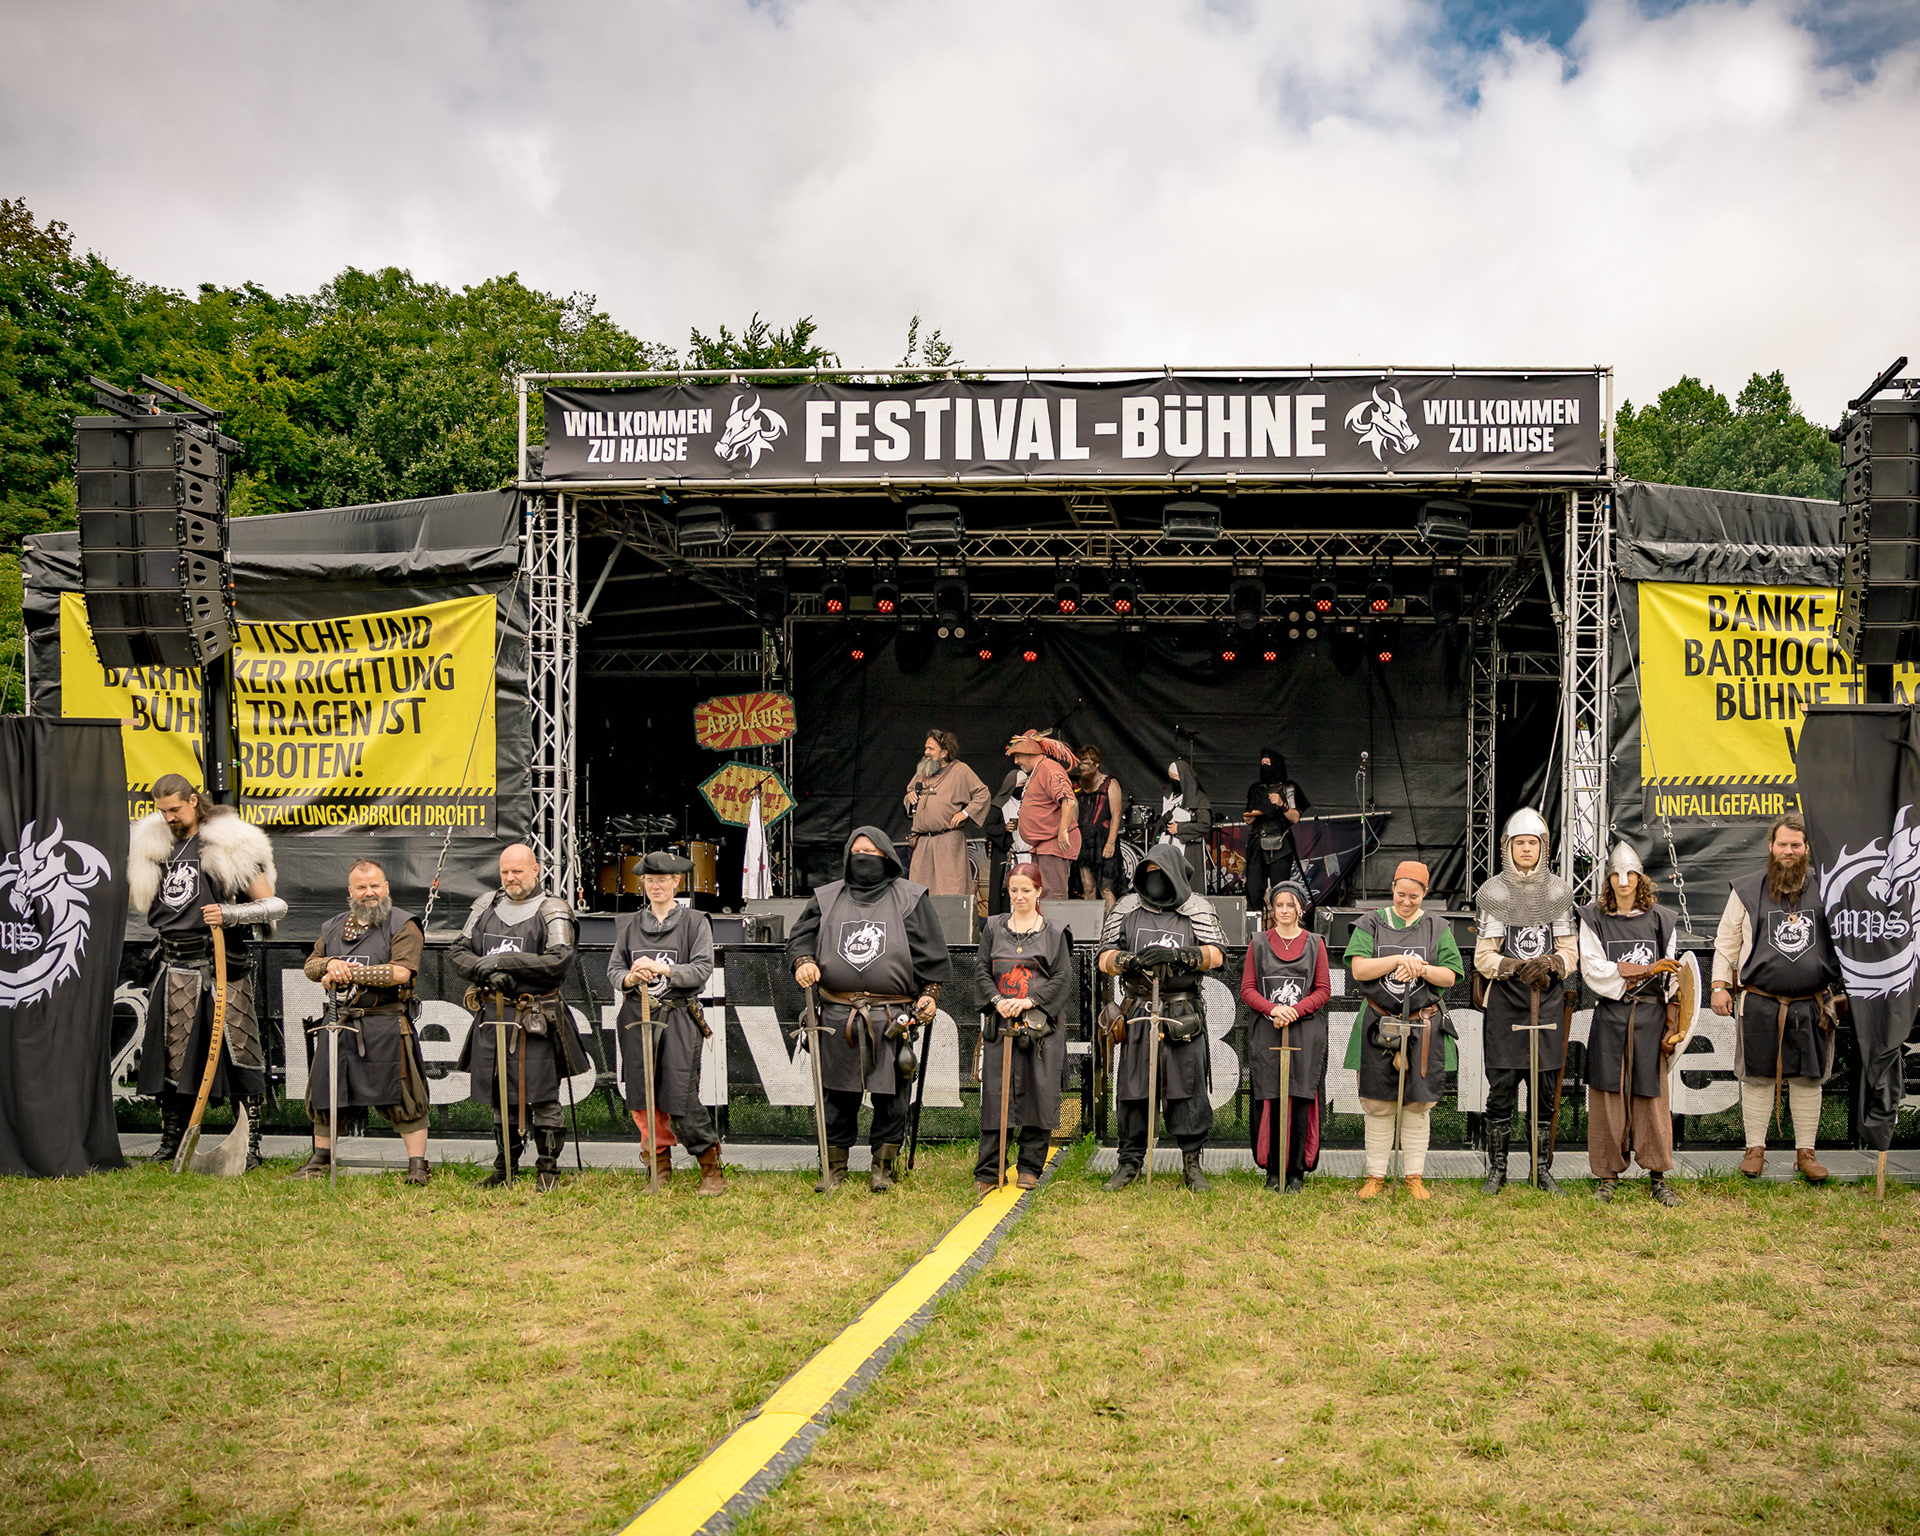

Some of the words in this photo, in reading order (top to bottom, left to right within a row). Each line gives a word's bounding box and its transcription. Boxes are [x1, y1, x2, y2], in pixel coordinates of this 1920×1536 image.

[563, 408, 713, 438] WILLKOMMEN
[805, 395, 1326, 463] FESTIVAL-BÜHNE
[1423, 399, 1580, 426] WILLKOMMEN
[586, 439, 616, 464] ZU
[618, 437, 688, 463] HAUSE
[1448, 427, 1478, 453] ZU
[1482, 427, 1555, 454] HAUSE
[240, 619, 358, 654] TISCHE
[361, 615, 433, 652] UND
[1684, 636, 1863, 676] BARHOCK
[294, 653, 455, 695] RICHTUNG
[131, 690, 203, 733] BÜH
[246, 699, 372, 737] TRAGEN
[377, 697, 427, 735] IST
[706, 708, 785, 735] APPLAUS
[192, 740, 365, 779] RBOTEN!
[712, 783, 782, 810] PROT!
[424, 804, 486, 826] DROHT!
[0, 920, 43, 955] PS
[1830, 908, 1911, 944] MPS
